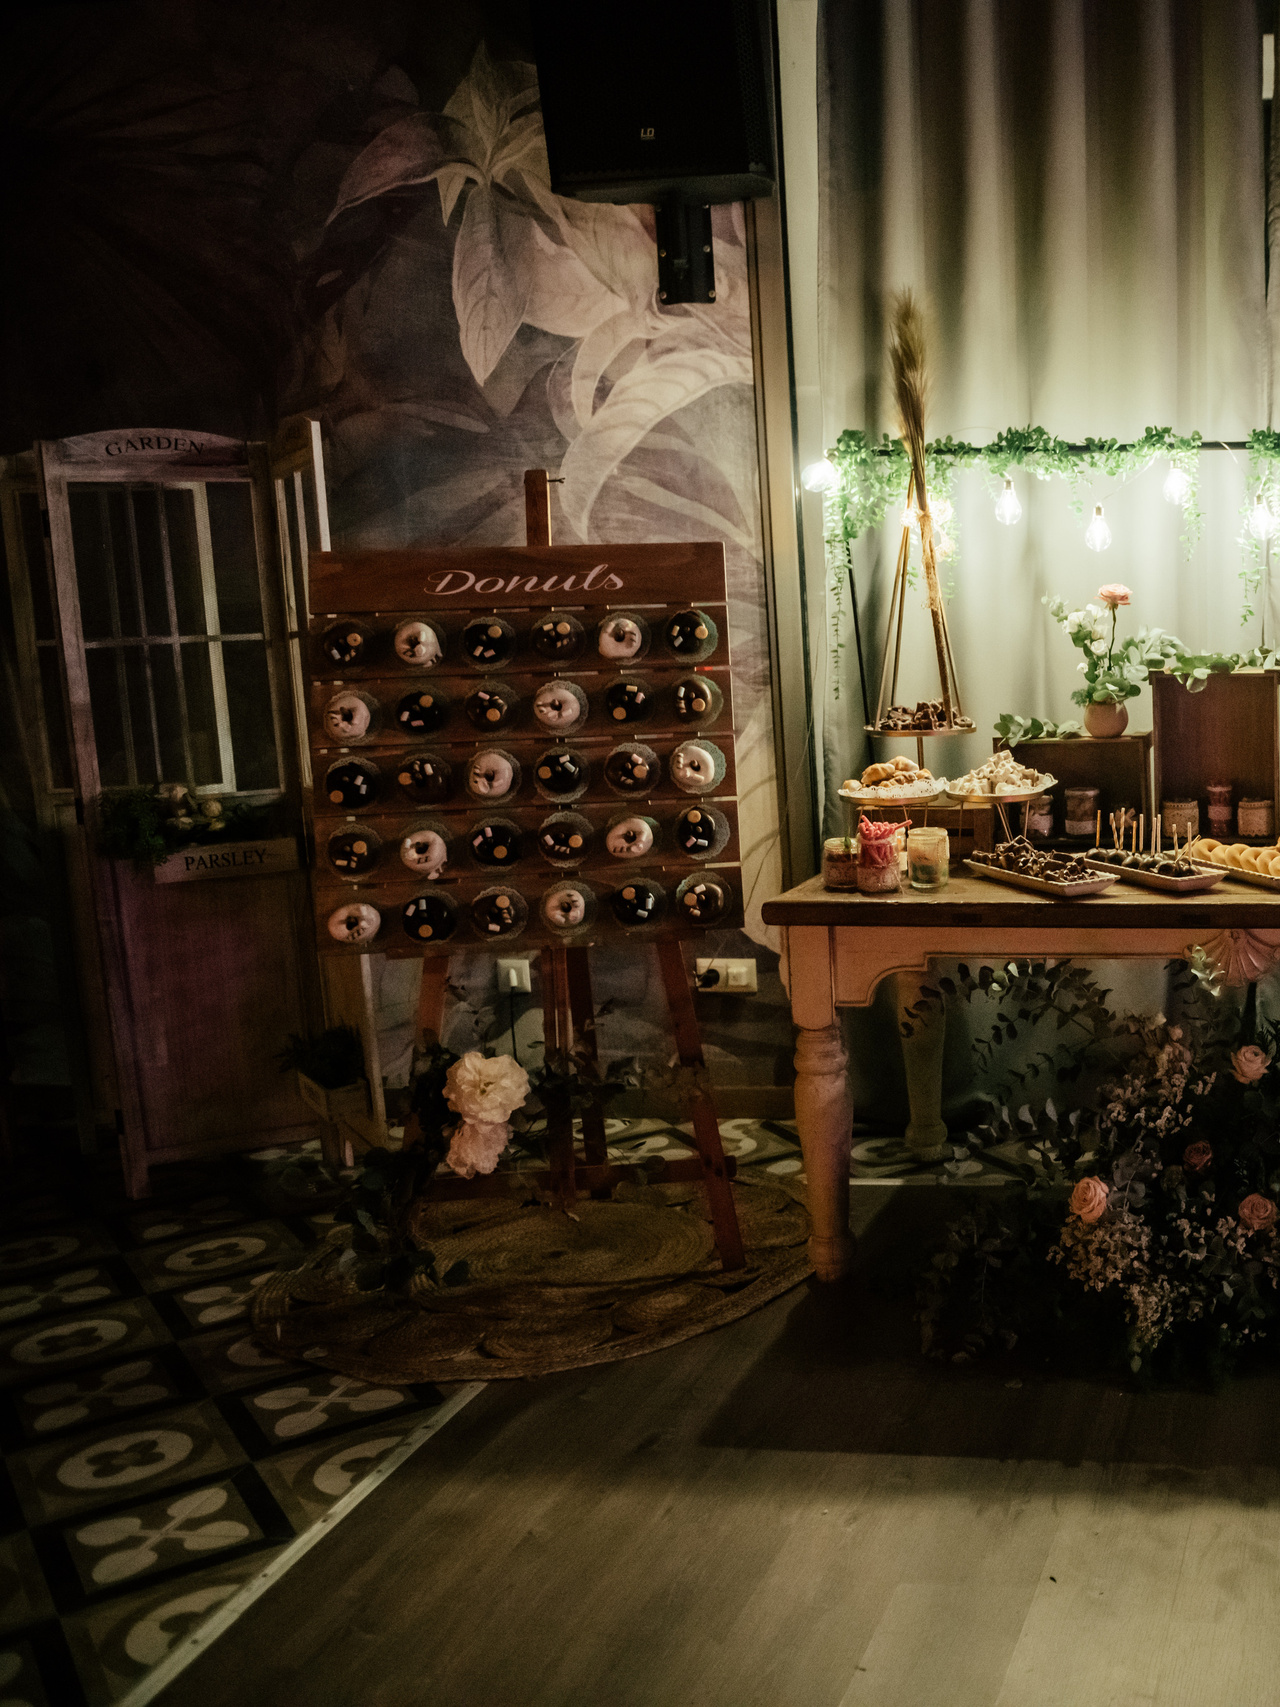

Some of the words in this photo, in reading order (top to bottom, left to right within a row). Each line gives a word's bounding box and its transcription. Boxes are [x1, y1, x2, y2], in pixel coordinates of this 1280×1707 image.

[105, 437, 204, 456] GARDEN
[424, 563, 624, 595] Donuts
[184, 848, 267, 871] PARSLEY
